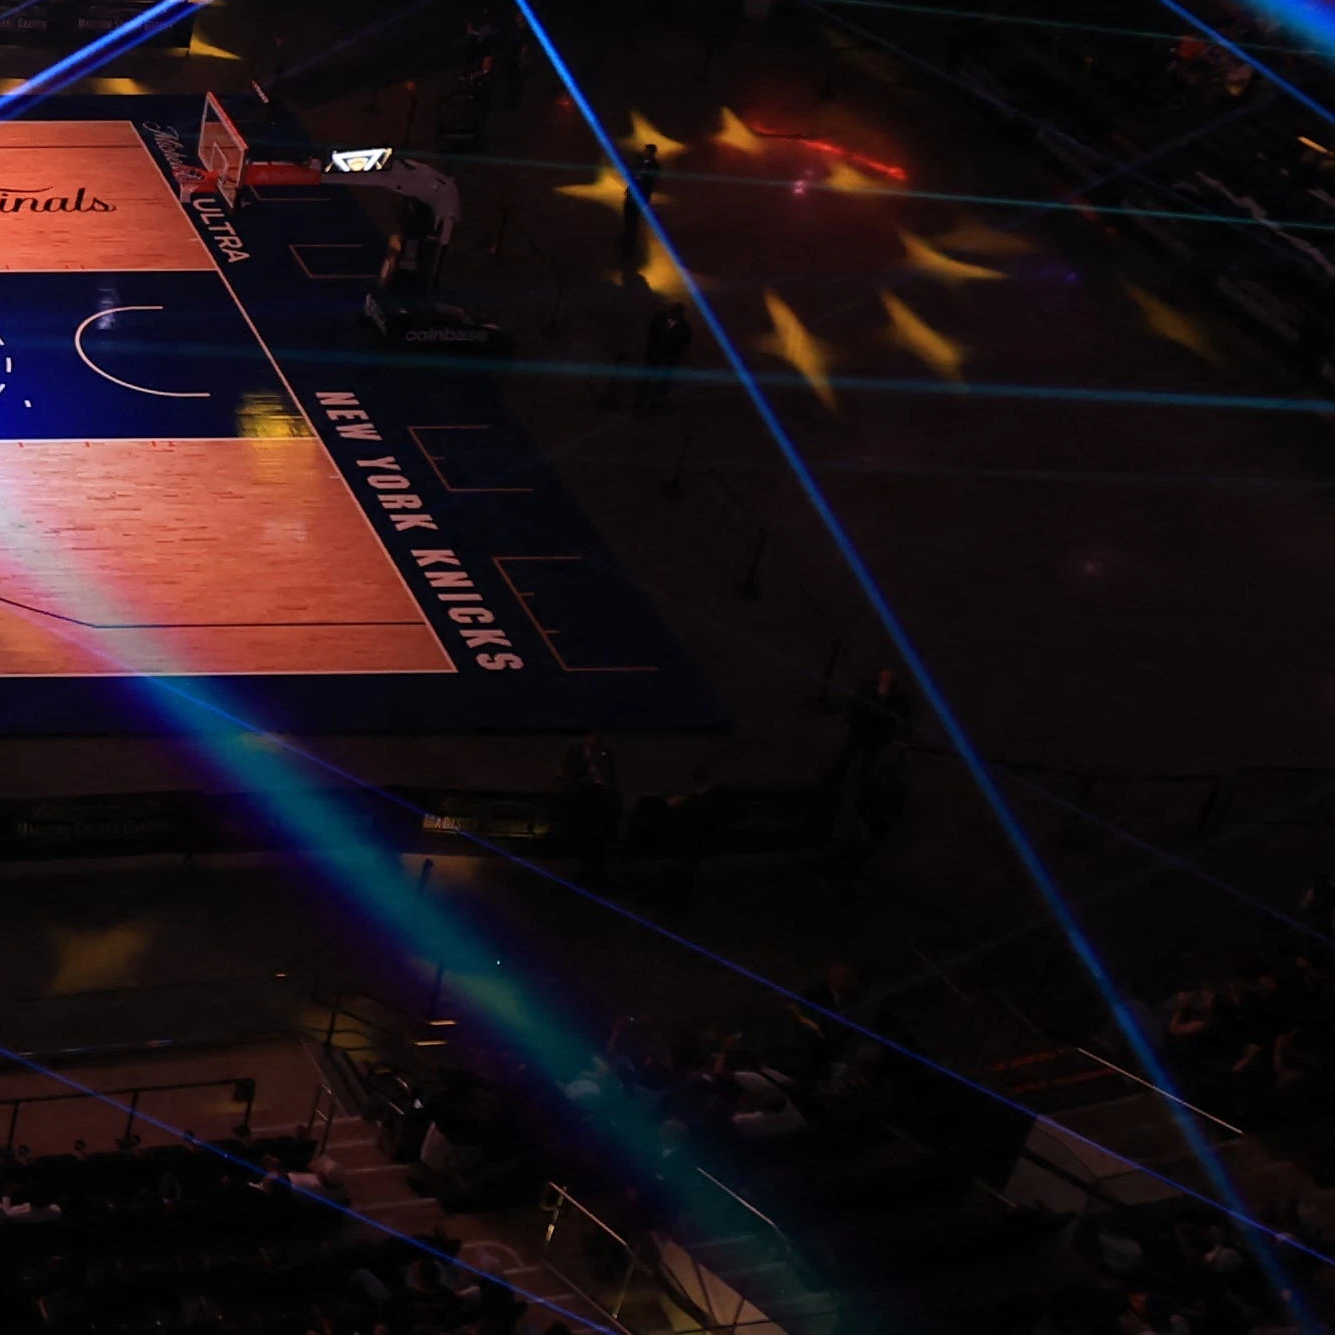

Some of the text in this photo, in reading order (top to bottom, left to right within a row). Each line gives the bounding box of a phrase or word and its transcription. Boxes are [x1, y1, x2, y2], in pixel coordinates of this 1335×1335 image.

[192, 198, 251, 264] ULTRA
[315, 391, 524, 670] NEW YORK KNICKS
